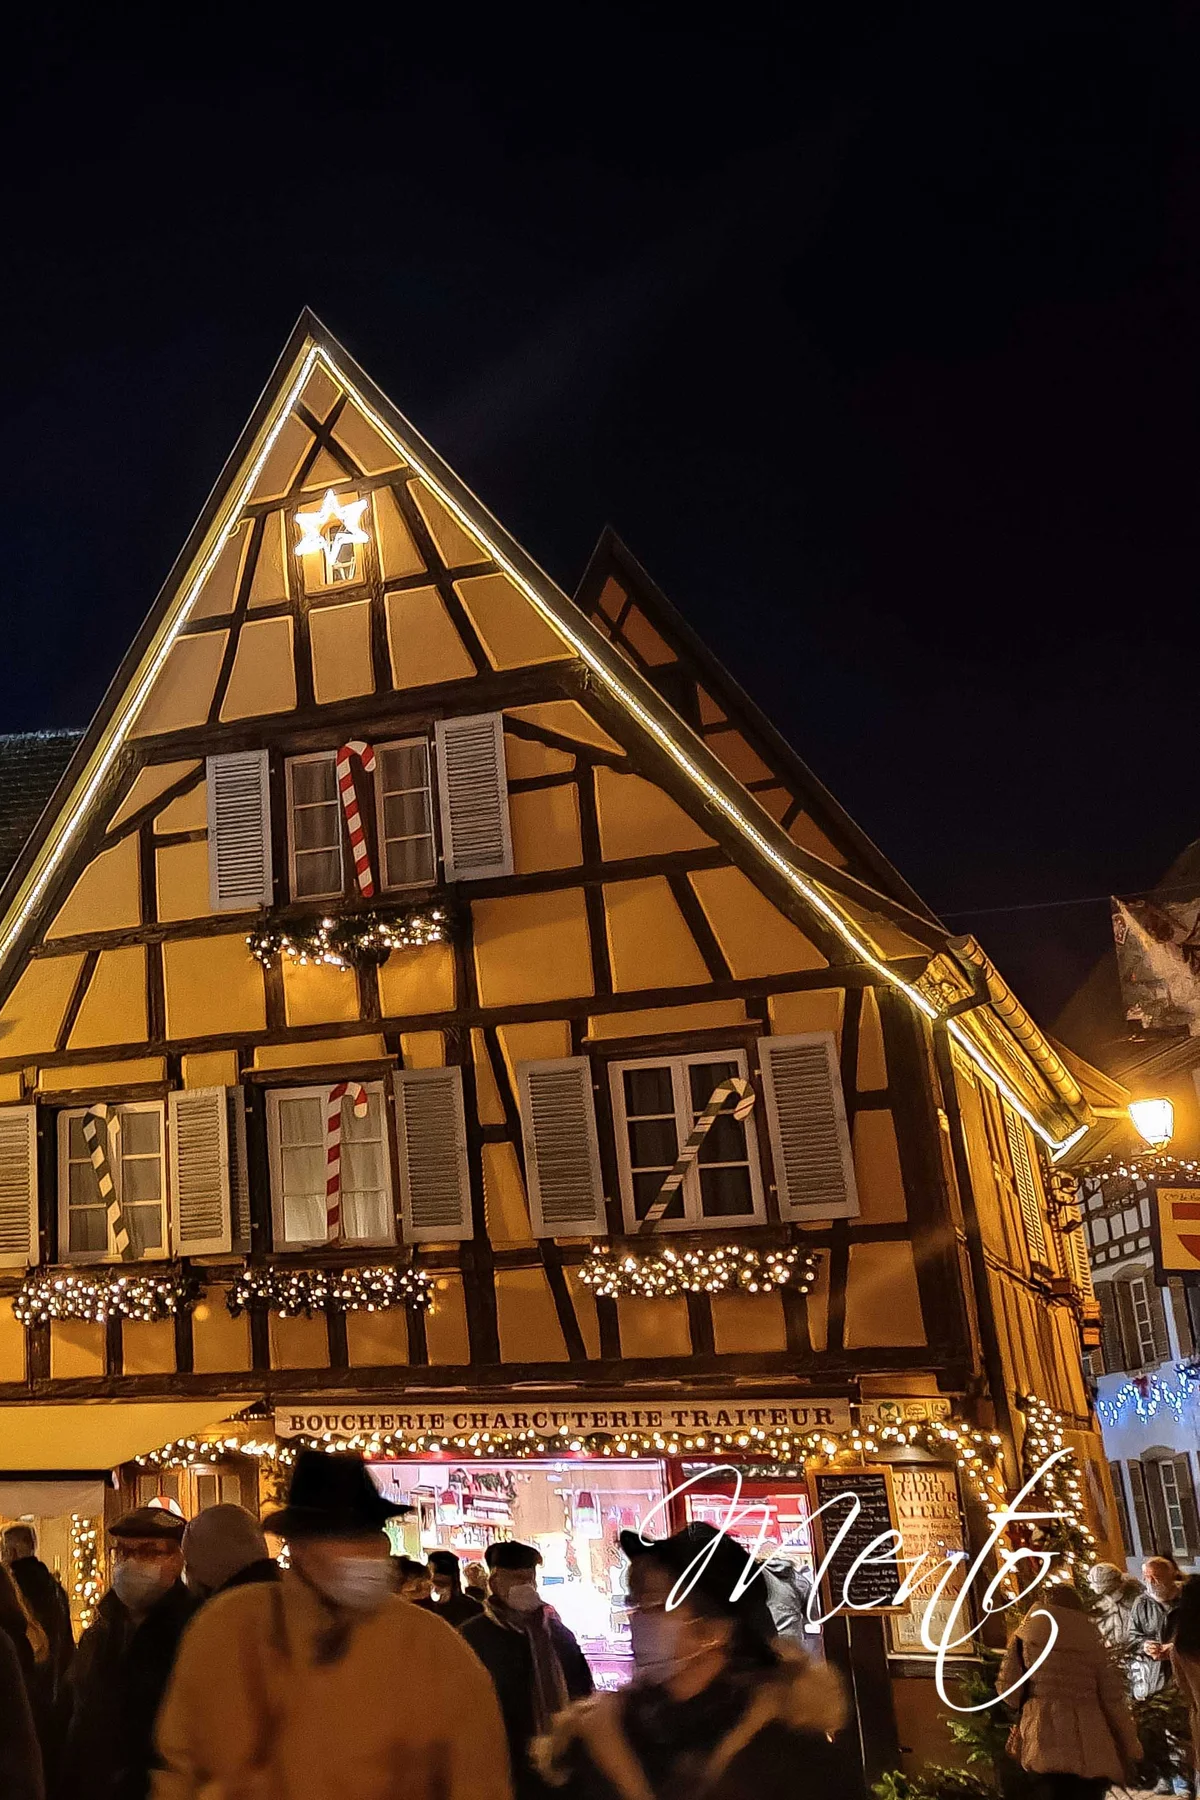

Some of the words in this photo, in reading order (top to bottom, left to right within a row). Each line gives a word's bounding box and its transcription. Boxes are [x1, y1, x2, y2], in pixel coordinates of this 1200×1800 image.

[289, 1413, 445, 1431] BOUCHERIE
[453, 1411, 663, 1430] CHARCUTERIE
[671, 1408, 835, 1428] TRAITEUR
